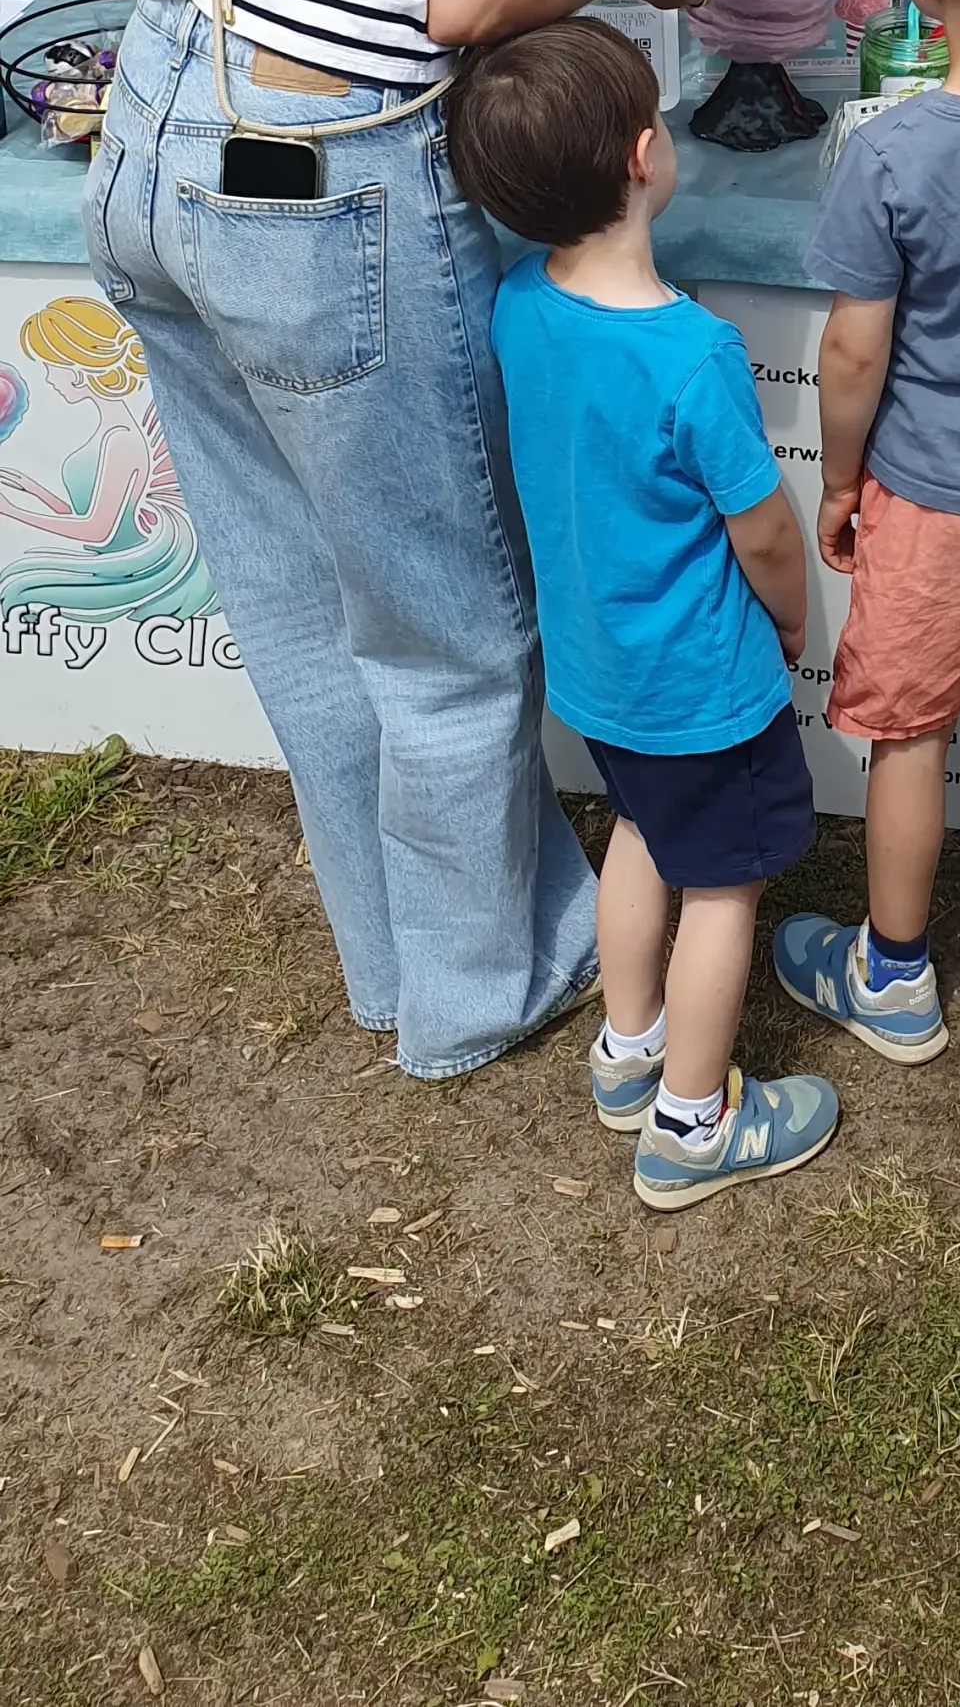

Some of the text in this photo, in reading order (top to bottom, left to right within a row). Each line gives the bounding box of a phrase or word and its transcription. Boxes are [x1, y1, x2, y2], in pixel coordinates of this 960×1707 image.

[769, 444, 823, 462] erw
[2, 604, 107, 669] ffy
[816, 968, 840, 1014] N
[735, 1120, 771, 1163] N
